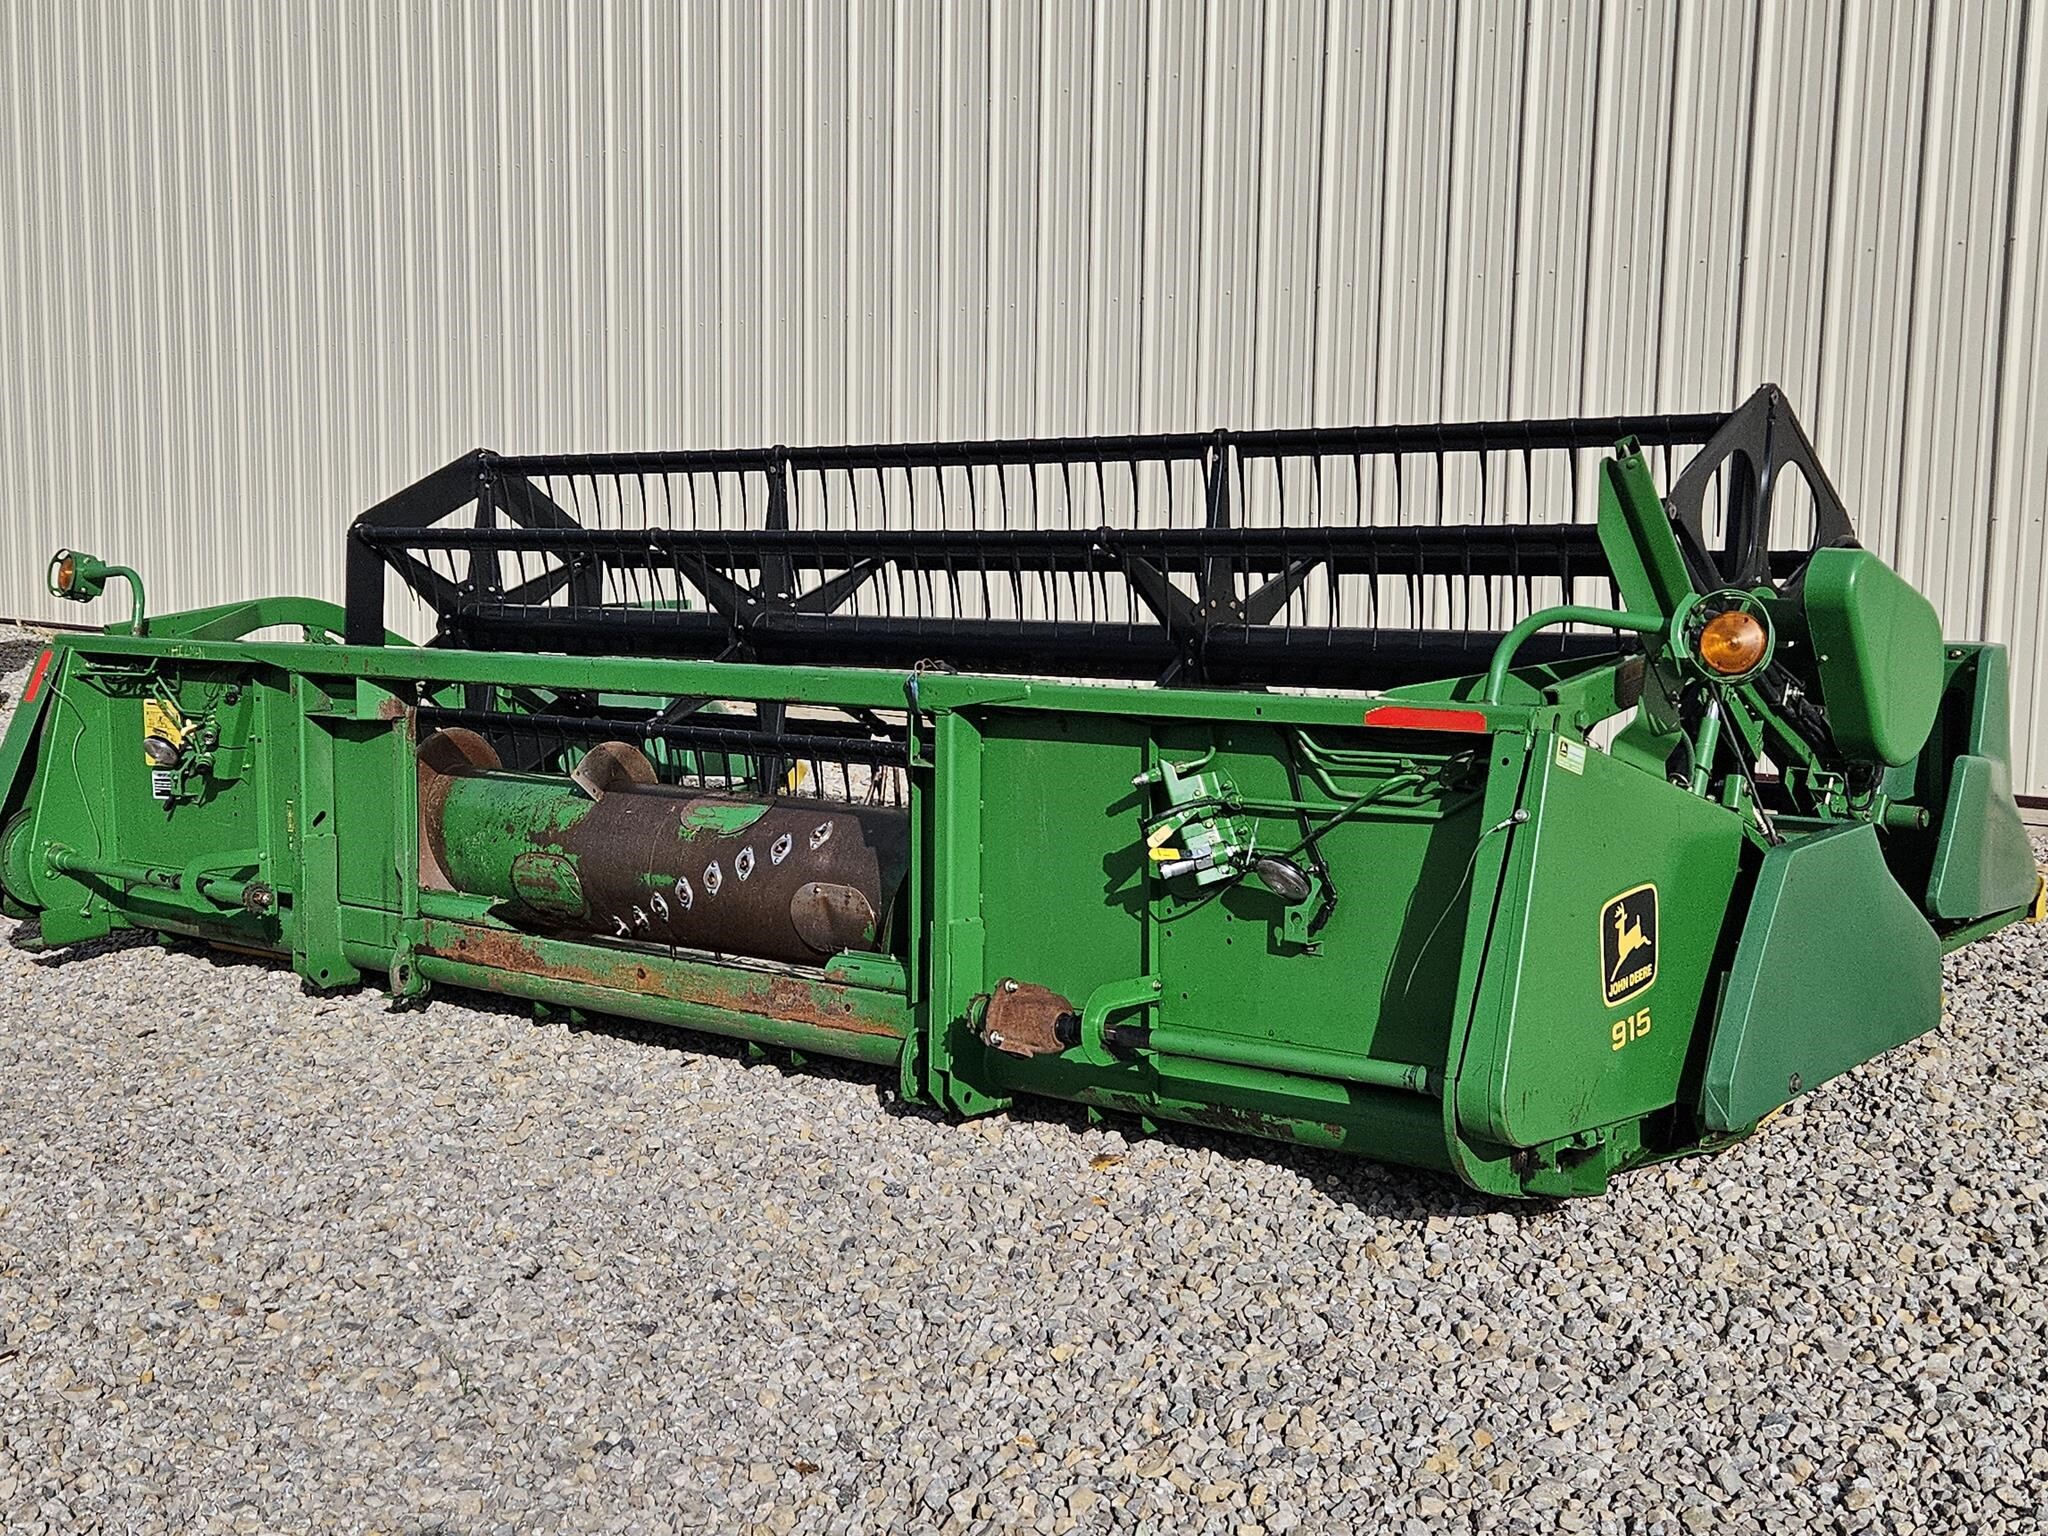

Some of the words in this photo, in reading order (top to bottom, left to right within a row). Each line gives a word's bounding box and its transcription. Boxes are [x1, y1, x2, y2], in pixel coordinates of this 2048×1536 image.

[1608, 978, 1629, 997] JOHN
[1629, 963, 1653, 987] DEERE
[1611, 1006, 1651, 1051] 915
